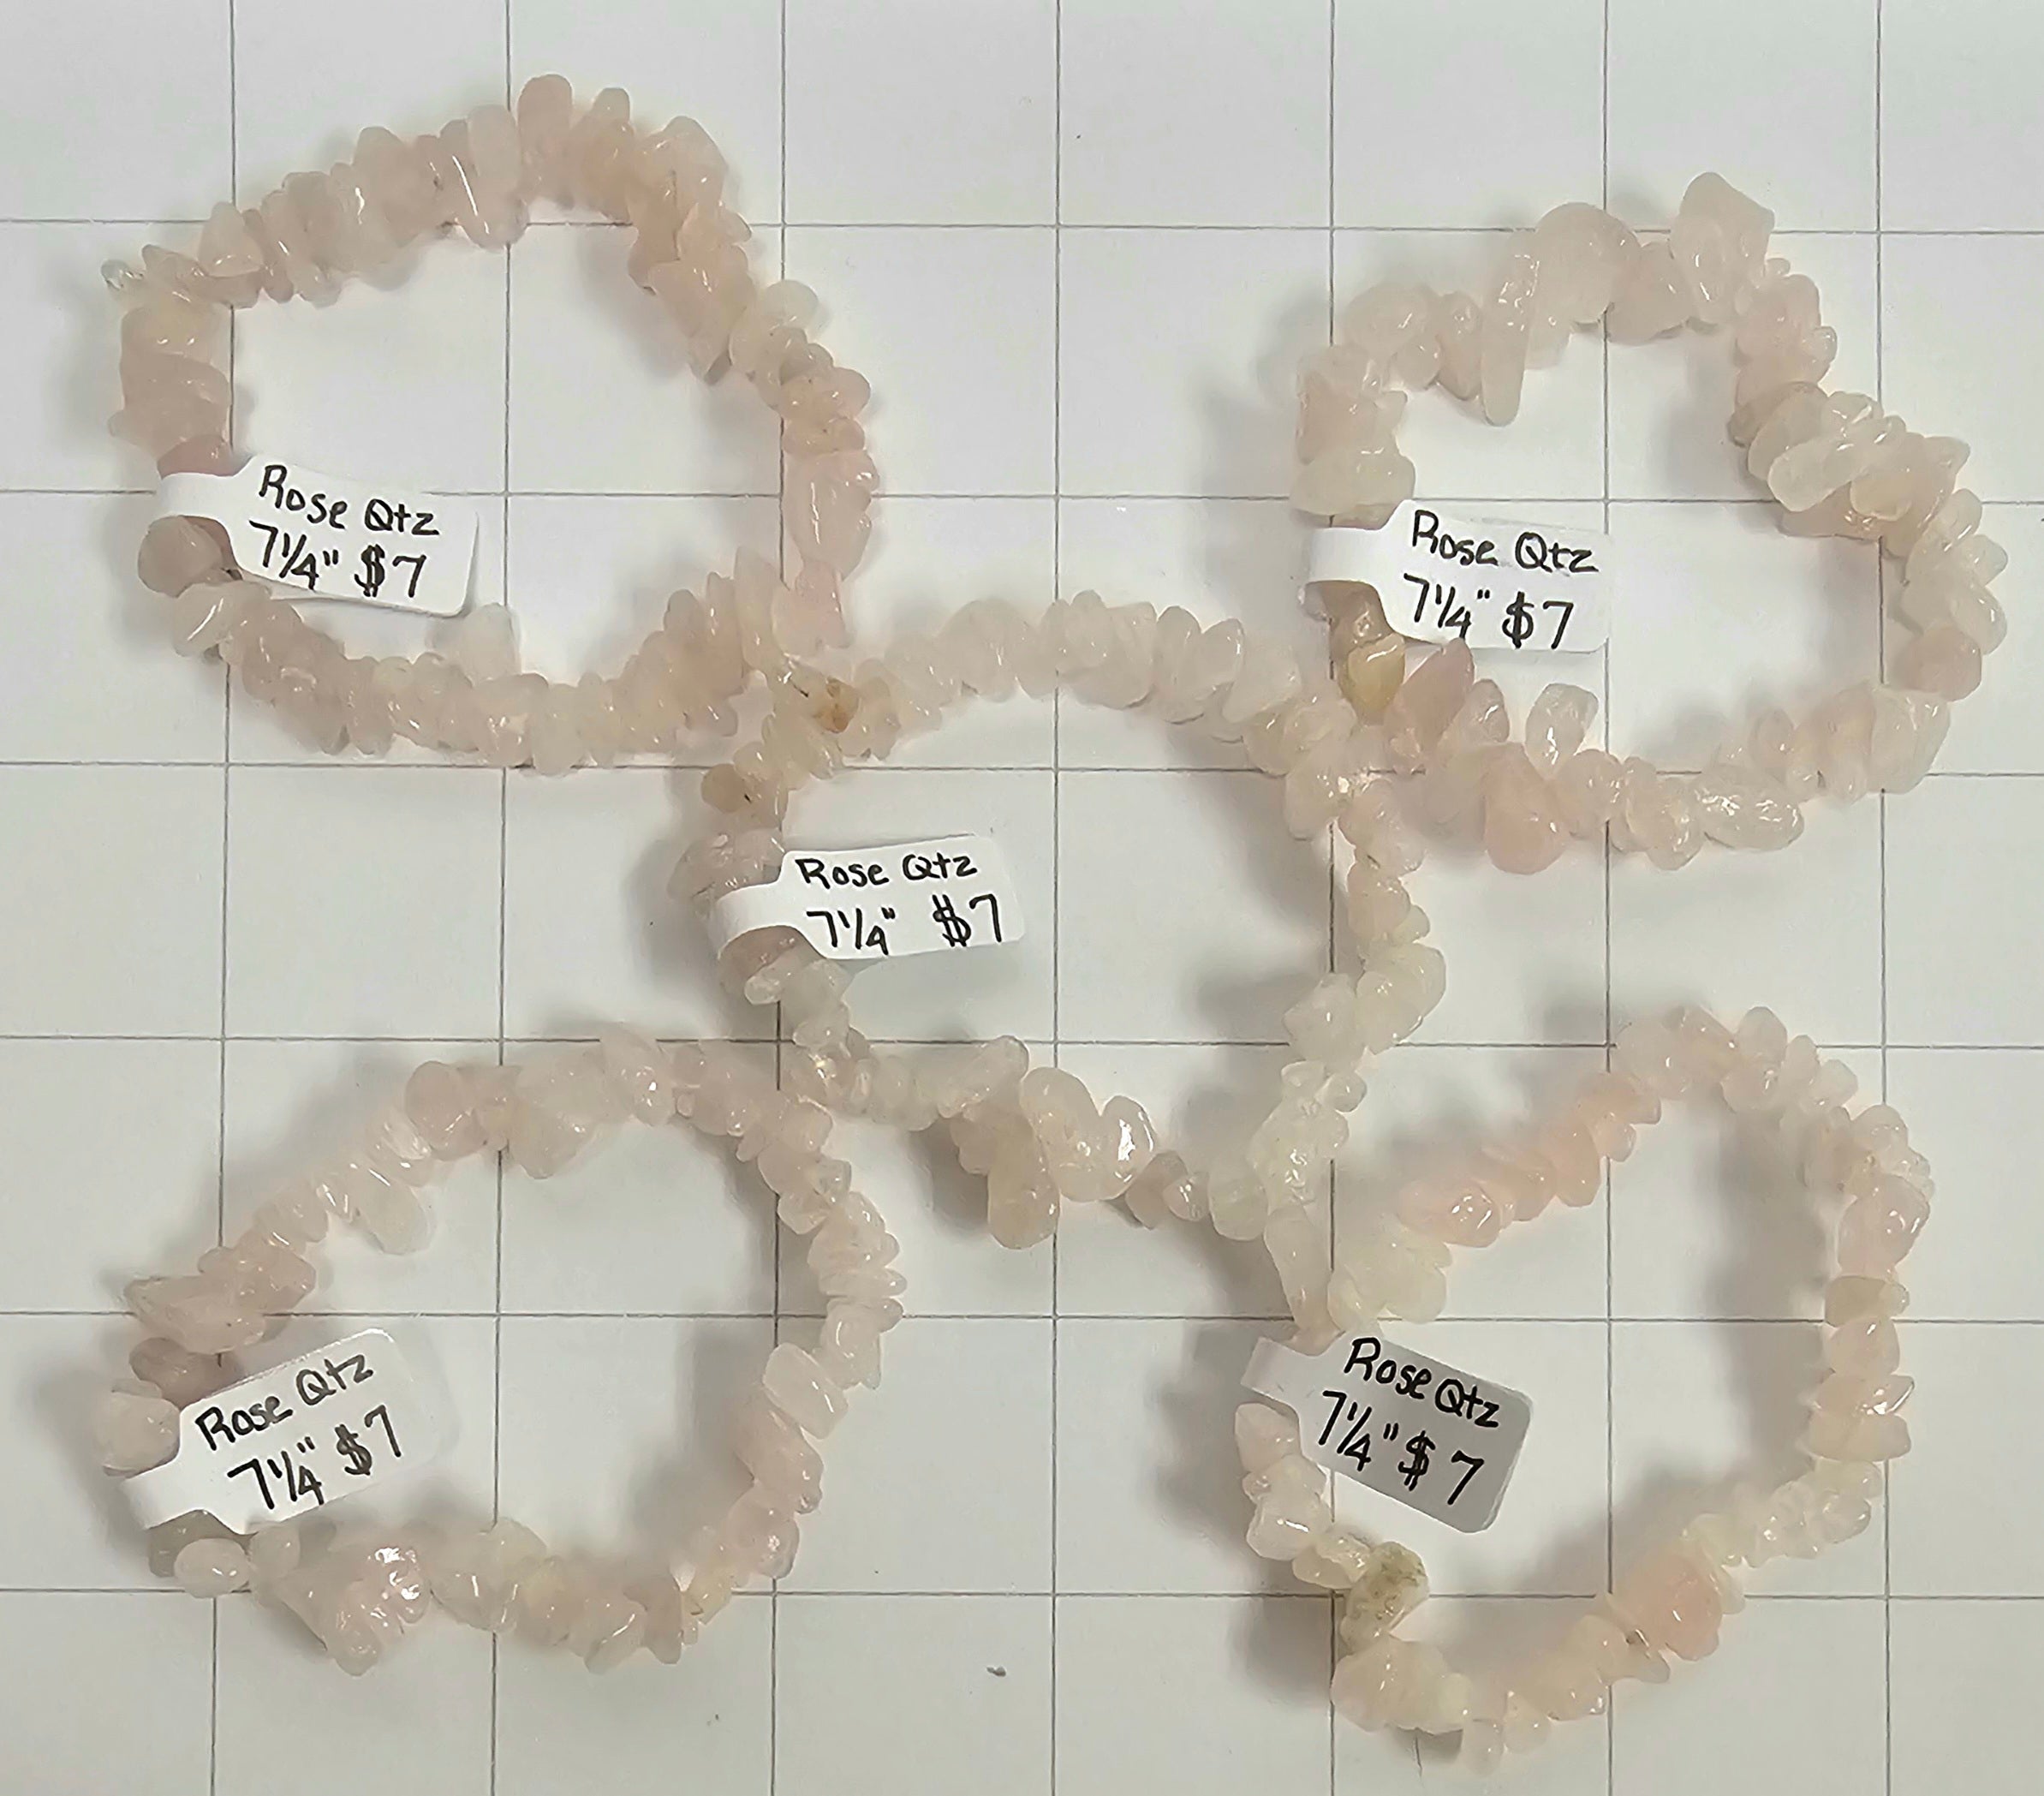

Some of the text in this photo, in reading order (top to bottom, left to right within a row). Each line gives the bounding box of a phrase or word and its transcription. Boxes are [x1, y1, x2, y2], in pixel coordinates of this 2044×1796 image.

[259, 465, 439, 535] Rose Qtz
[1413, 510, 1598, 572] Rose Qtz
[796, 853, 977, 889] Rose Qtz
[195, 1356, 373, 1451] Rose Qtz
[1344, 1338, 1499, 1428] Rose Qtz
